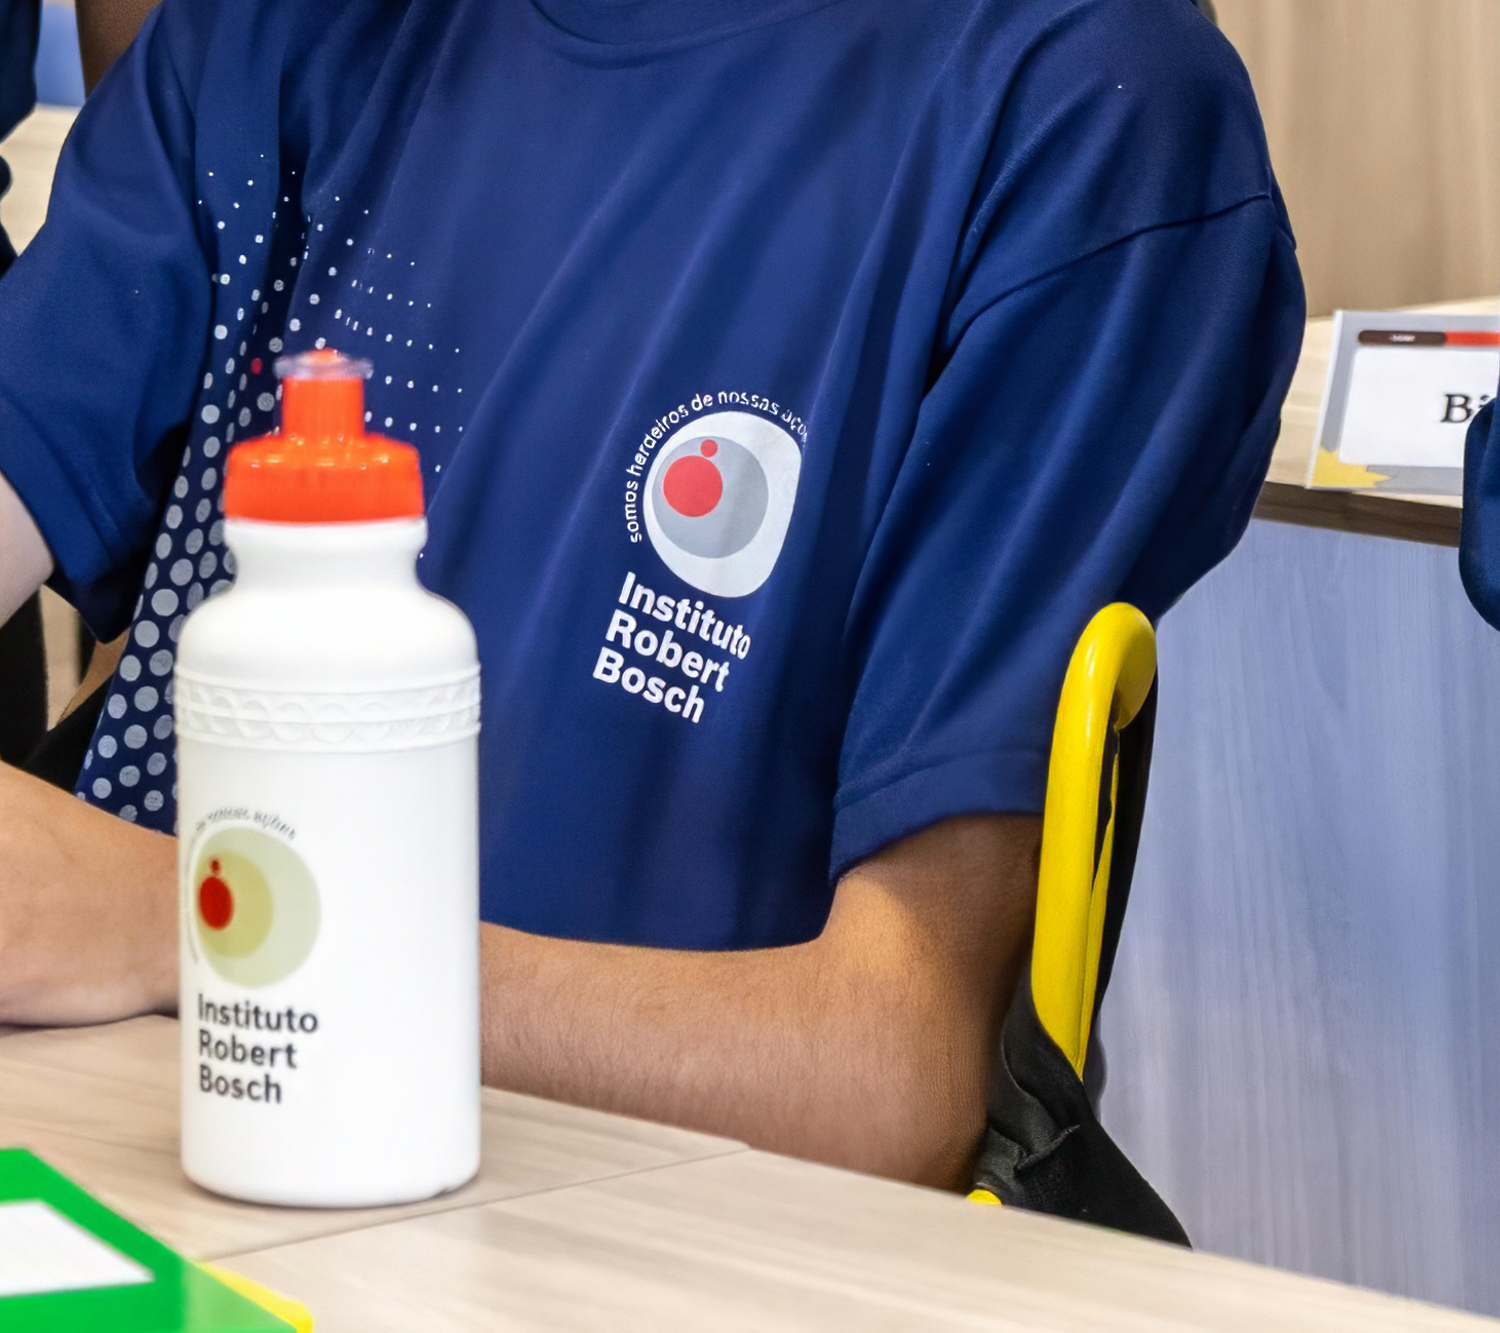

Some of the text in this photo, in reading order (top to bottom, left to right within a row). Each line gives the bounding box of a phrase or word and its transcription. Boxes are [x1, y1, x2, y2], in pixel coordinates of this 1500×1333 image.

[690, 393, 713, 412] de
[717, 390, 780, 416] nossas
[626, 403, 689, 478] herdeiros
[624, 479, 642, 543] somos
[618, 571, 751, 660] Instituto
[605, 608, 730, 693] Robert
[592, 646, 705, 724] Bosch
[198, 992, 318, 1034] Instituto
[199, 1029, 297, 1069] Robert
[199, 1064, 281, 1104] Bosch
